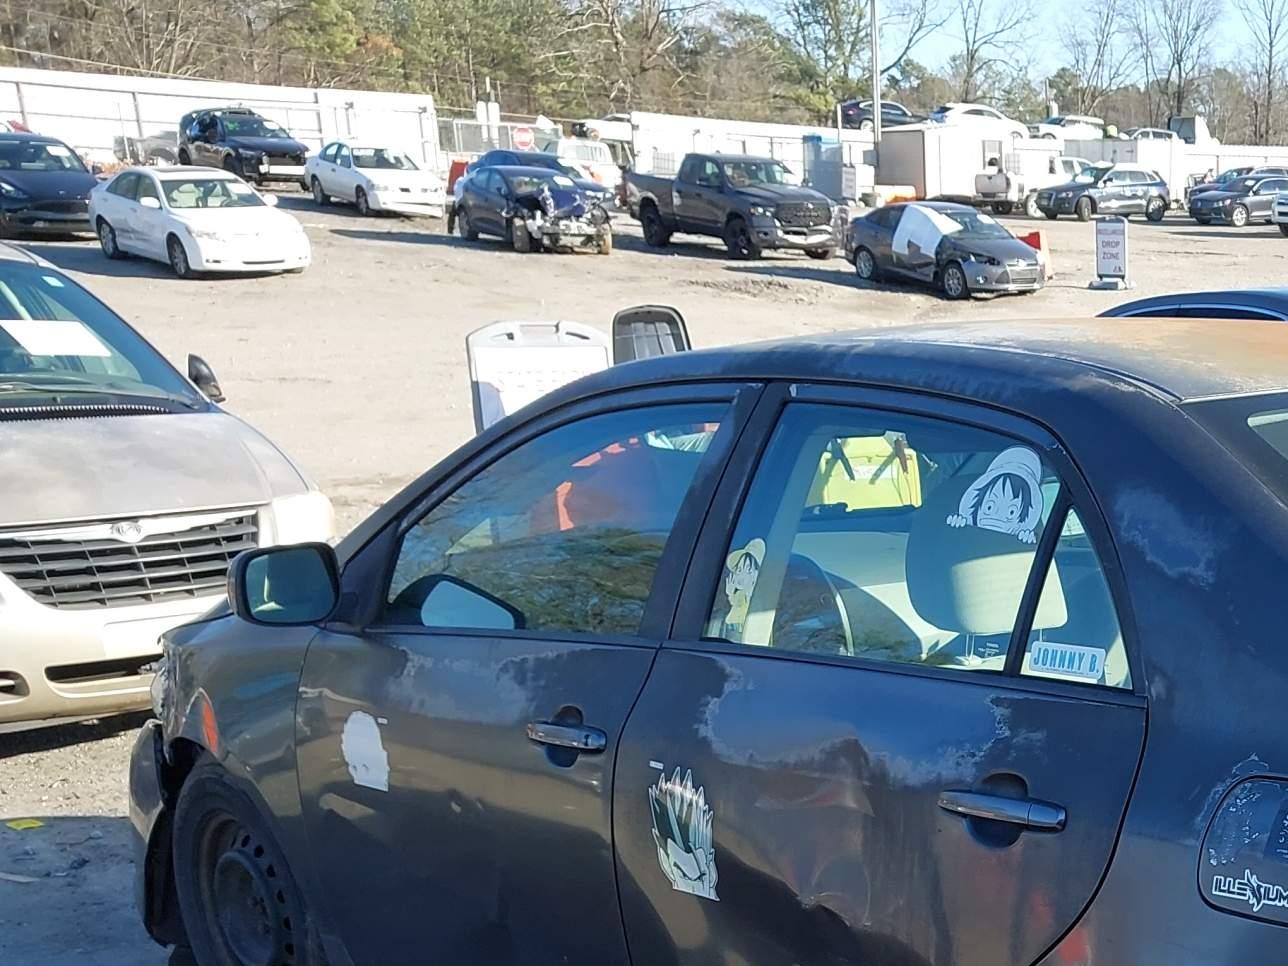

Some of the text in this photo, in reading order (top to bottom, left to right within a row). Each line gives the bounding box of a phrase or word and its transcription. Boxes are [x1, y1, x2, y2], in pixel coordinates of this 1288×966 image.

[1102, 240, 1120, 248] DROP
[1103, 251, 1120, 260] ZONE
[1033, 647, 1085, 671] JOHNNY
[1088, 653, 1100, 673] B.
